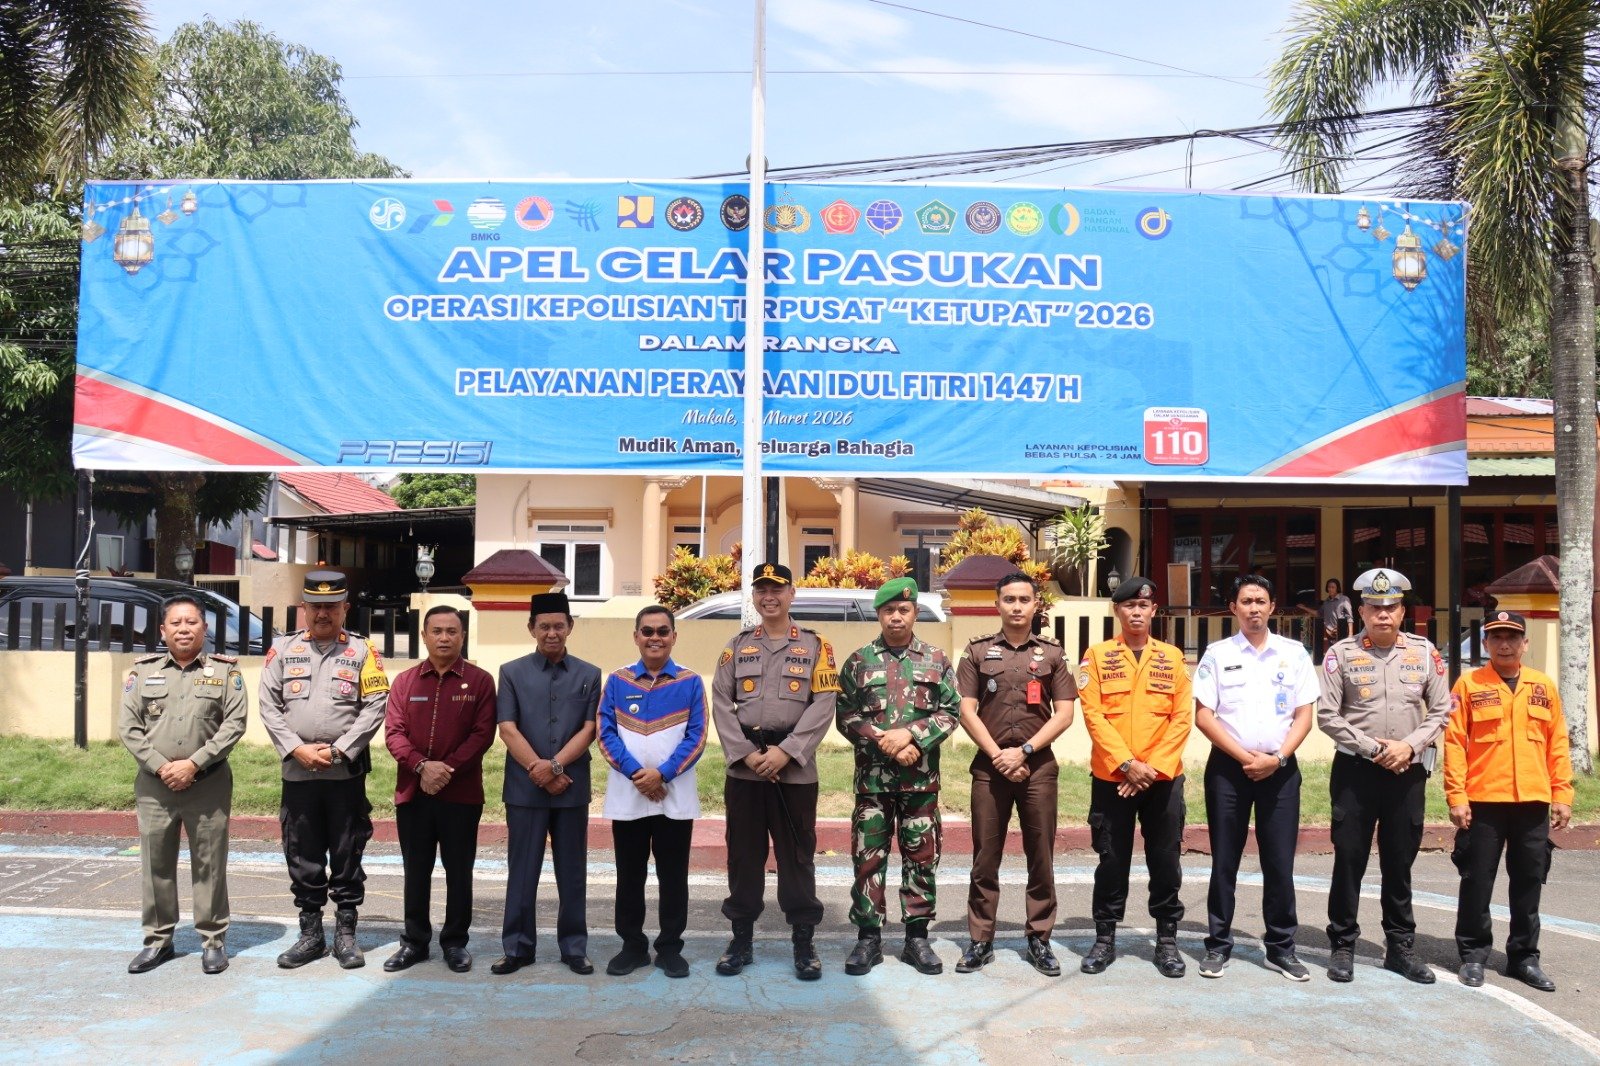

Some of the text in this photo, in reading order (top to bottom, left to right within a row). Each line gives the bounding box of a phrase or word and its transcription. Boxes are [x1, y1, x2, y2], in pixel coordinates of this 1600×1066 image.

[1083, 208, 1116, 216] BADAN
[1084, 216, 1122, 225] PANGAN
[1084, 225, 1131, 234] NASIONAL
[470, 233, 500, 241] BMKG
[440, 248, 1100, 289] APEL GELAR PASUKAN
[385, 296, 519, 320] OPERASI
[526, 296, 715, 321] KEPOLISIAN
[719, 296, 884, 322] TRPUSAT
[1077, 303, 1153, 328] 2026
[639, 334, 900, 354] DALAM RANGKA
[457, 369, 645, 396] PELAYANAN
[826, 371, 898, 398] IDUL
[903, 372, 977, 400] FITRI
[981, 373, 1056, 401] 1447
[1058, 374, 1081, 402] H
[681, 408, 854, 427] Makale, Maret 2026
[619, 437, 914, 458] Mudik Aman, eluarga Bahagia
[1025, 443, 1138, 452] LAYANAN KEPOLISIAN
[1151, 430, 1203, 456] 110
[336, 440, 493, 465] PRESISI
[1024, 451, 1060, 459] BEBAS
[1062, 452, 1098, 460] PULSA
[335, 658, 361, 668] POLRI
[738, 655, 761, 664] BUDY
[784, 656, 811, 665] POLRI
[1400, 664, 1424, 672] POLRI
[818, 673, 829, 688] KA
[1101, 671, 1127, 681] MAICKEL
